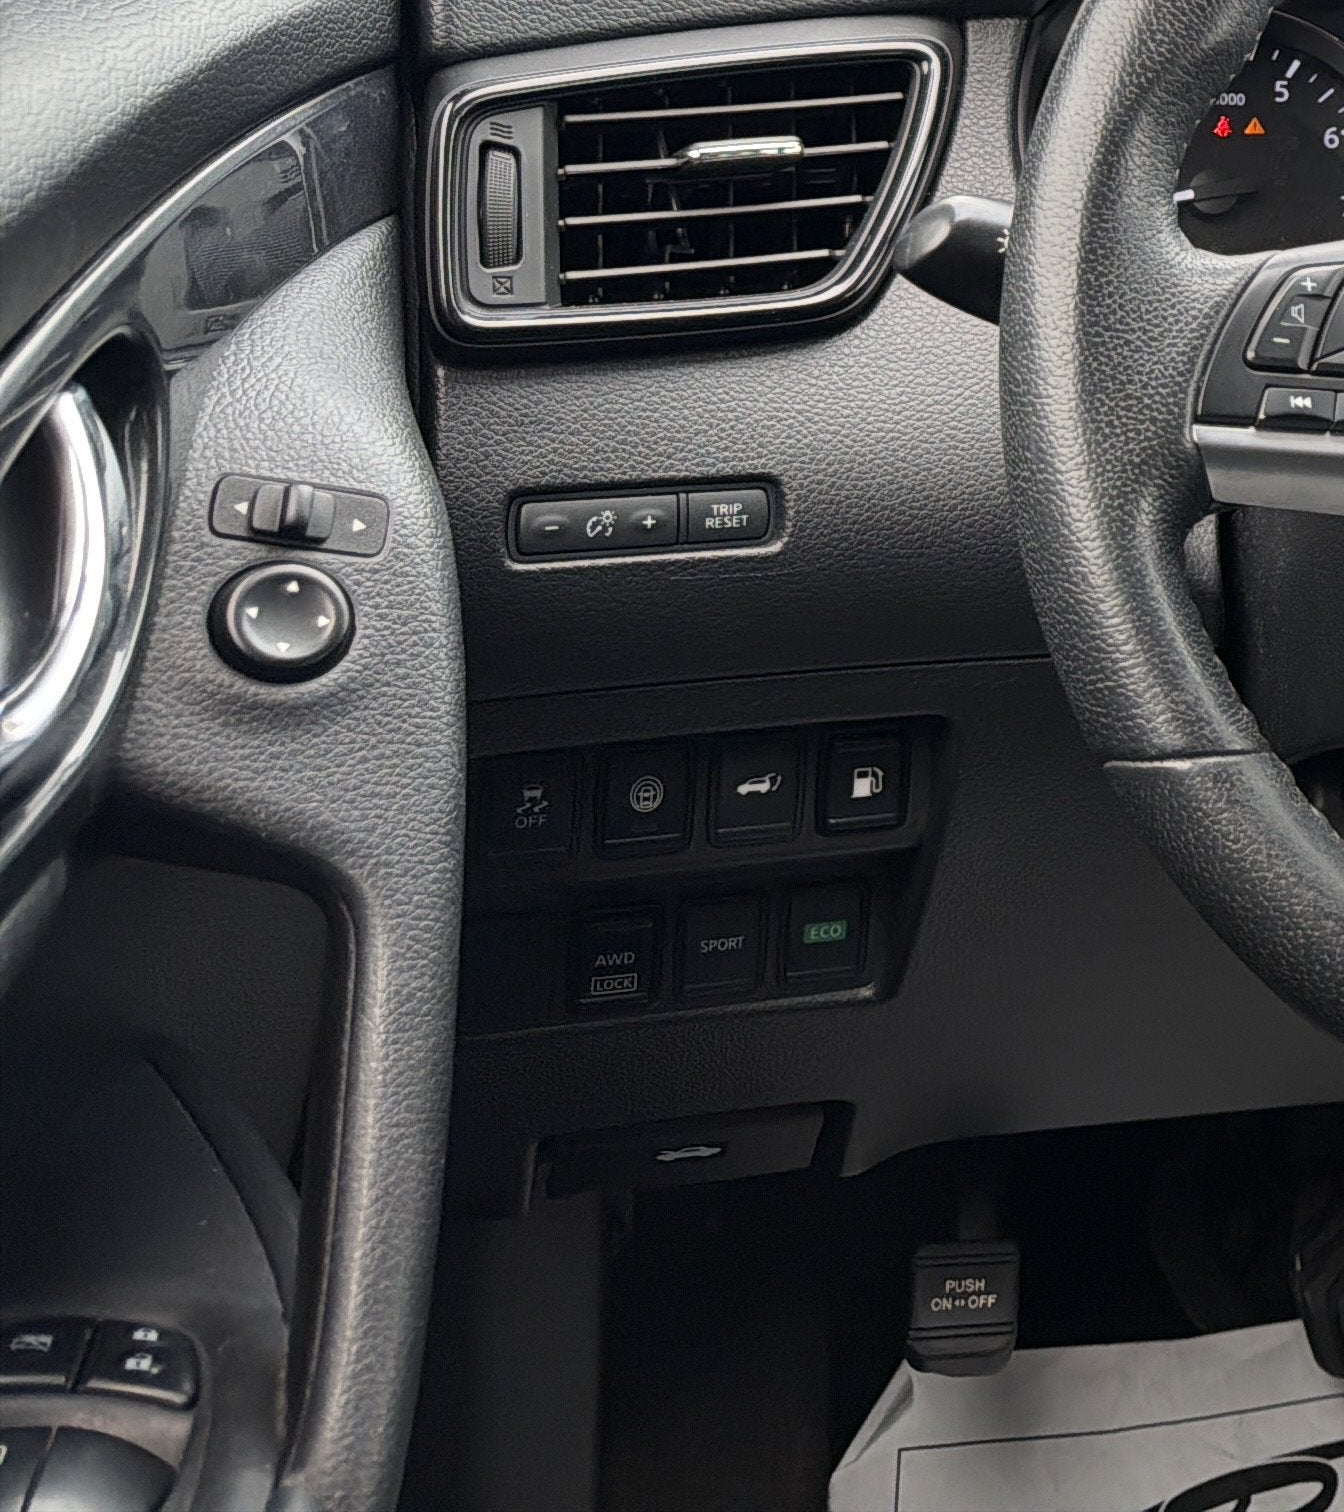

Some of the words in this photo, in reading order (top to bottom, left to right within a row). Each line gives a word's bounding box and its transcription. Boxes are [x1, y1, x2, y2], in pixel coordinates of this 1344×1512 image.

[1273, 80, 1290, 102] 5
[1324, 127, 1340, 149] 6
[711, 503, 743, 516] TRIP
[705, 514, 750, 528] RESET
[514, 814, 547, 829] OFF
[810, 923, 842, 941] ECO
[700, 936, 745, 954] SPORT
[594, 950, 635, 968] AWD
[596, 975, 633, 991] LOCK
[945, 1278, 986, 1293] PUSH
[931, 1297, 953, 1312] ON
[968, 1294, 997, 1309] OFF
